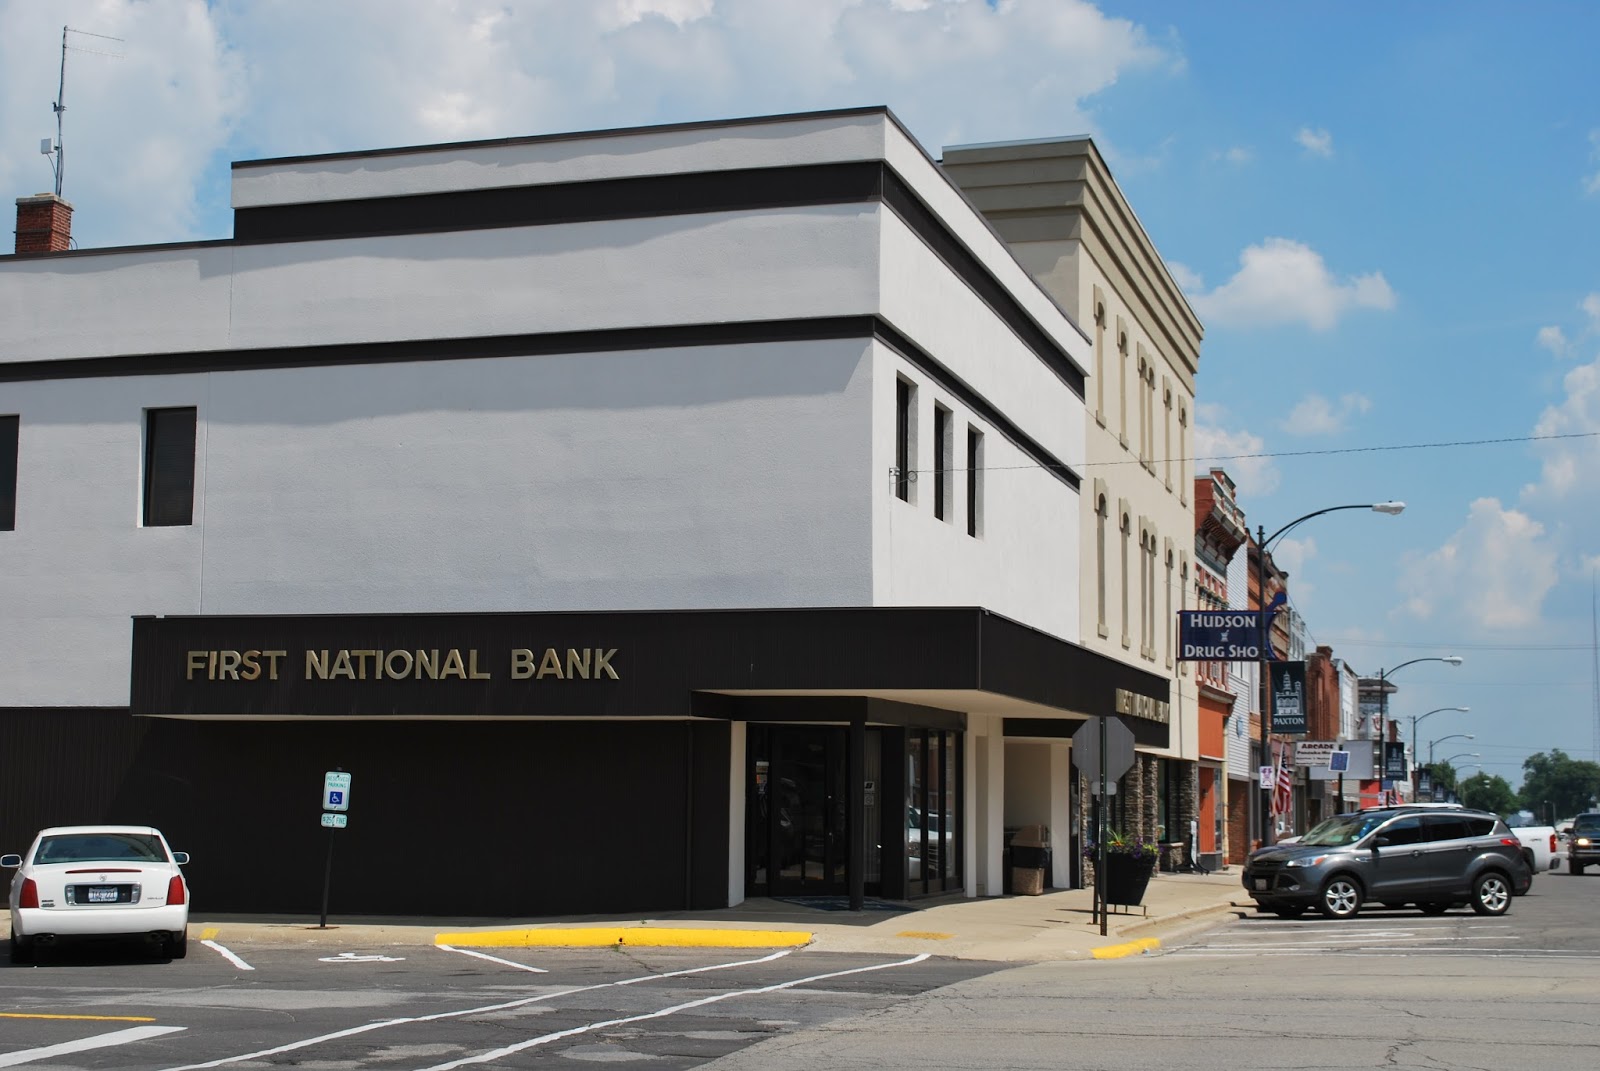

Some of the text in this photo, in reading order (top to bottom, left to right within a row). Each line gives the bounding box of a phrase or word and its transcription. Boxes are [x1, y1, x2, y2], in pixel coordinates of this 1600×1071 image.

[1190, 613, 1257, 628] HUDSON
[1184, 643, 1259, 658] DRUG SHO
[186, 648, 620, 681] FIRST NATIONAL BANK
[1273, 717, 1305, 726] PAXTON
[336, 816, 346, 825] FINE
